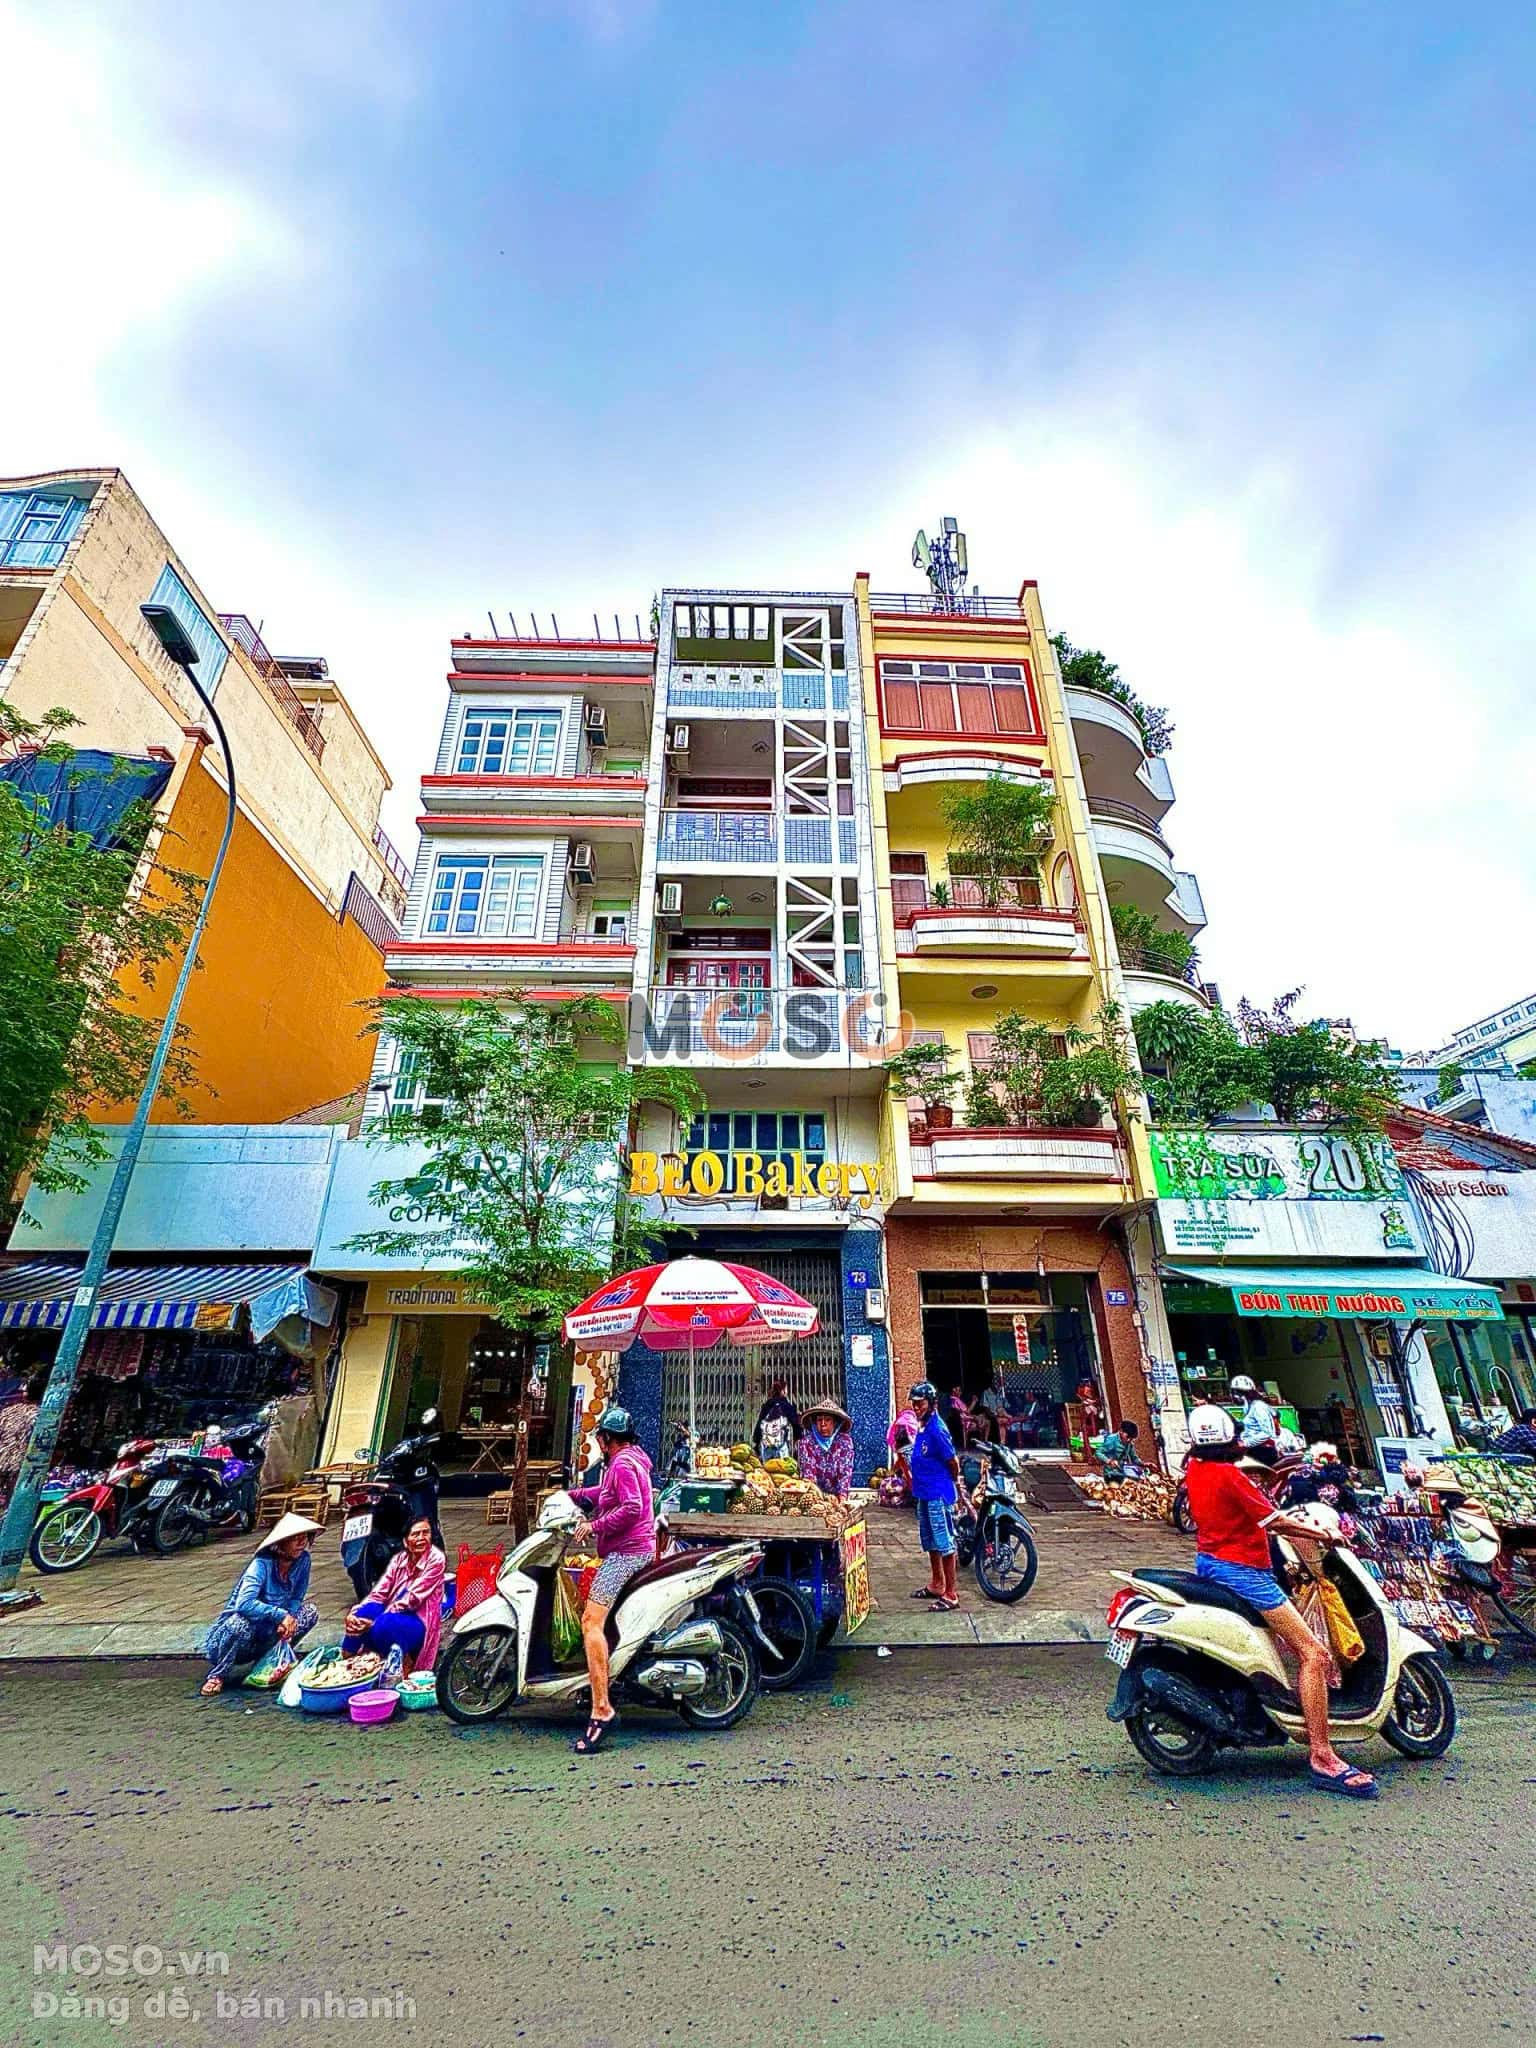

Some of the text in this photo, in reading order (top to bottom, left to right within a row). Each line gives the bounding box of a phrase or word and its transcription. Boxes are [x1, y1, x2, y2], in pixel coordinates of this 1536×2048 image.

[1161, 1150, 1215, 1178] TRÀ
[733, 1151, 885, 1209] Bakery
[1458, 1180, 1509, 1197] Salon
[851, 1271, 867, 1284] 73
[387, 1287, 459, 1305] TRADITIONAL
[592, 1289, 635, 1310] OMO
[1108, 1291, 1125, 1301] 75
[1239, 1290, 1282, 1310] BÚN
[1287, 1294, 1329, 1316] THỊT
[1336, 1291, 1407, 1313] NƯỚNG
[691, 1316, 710, 1326] OMO
